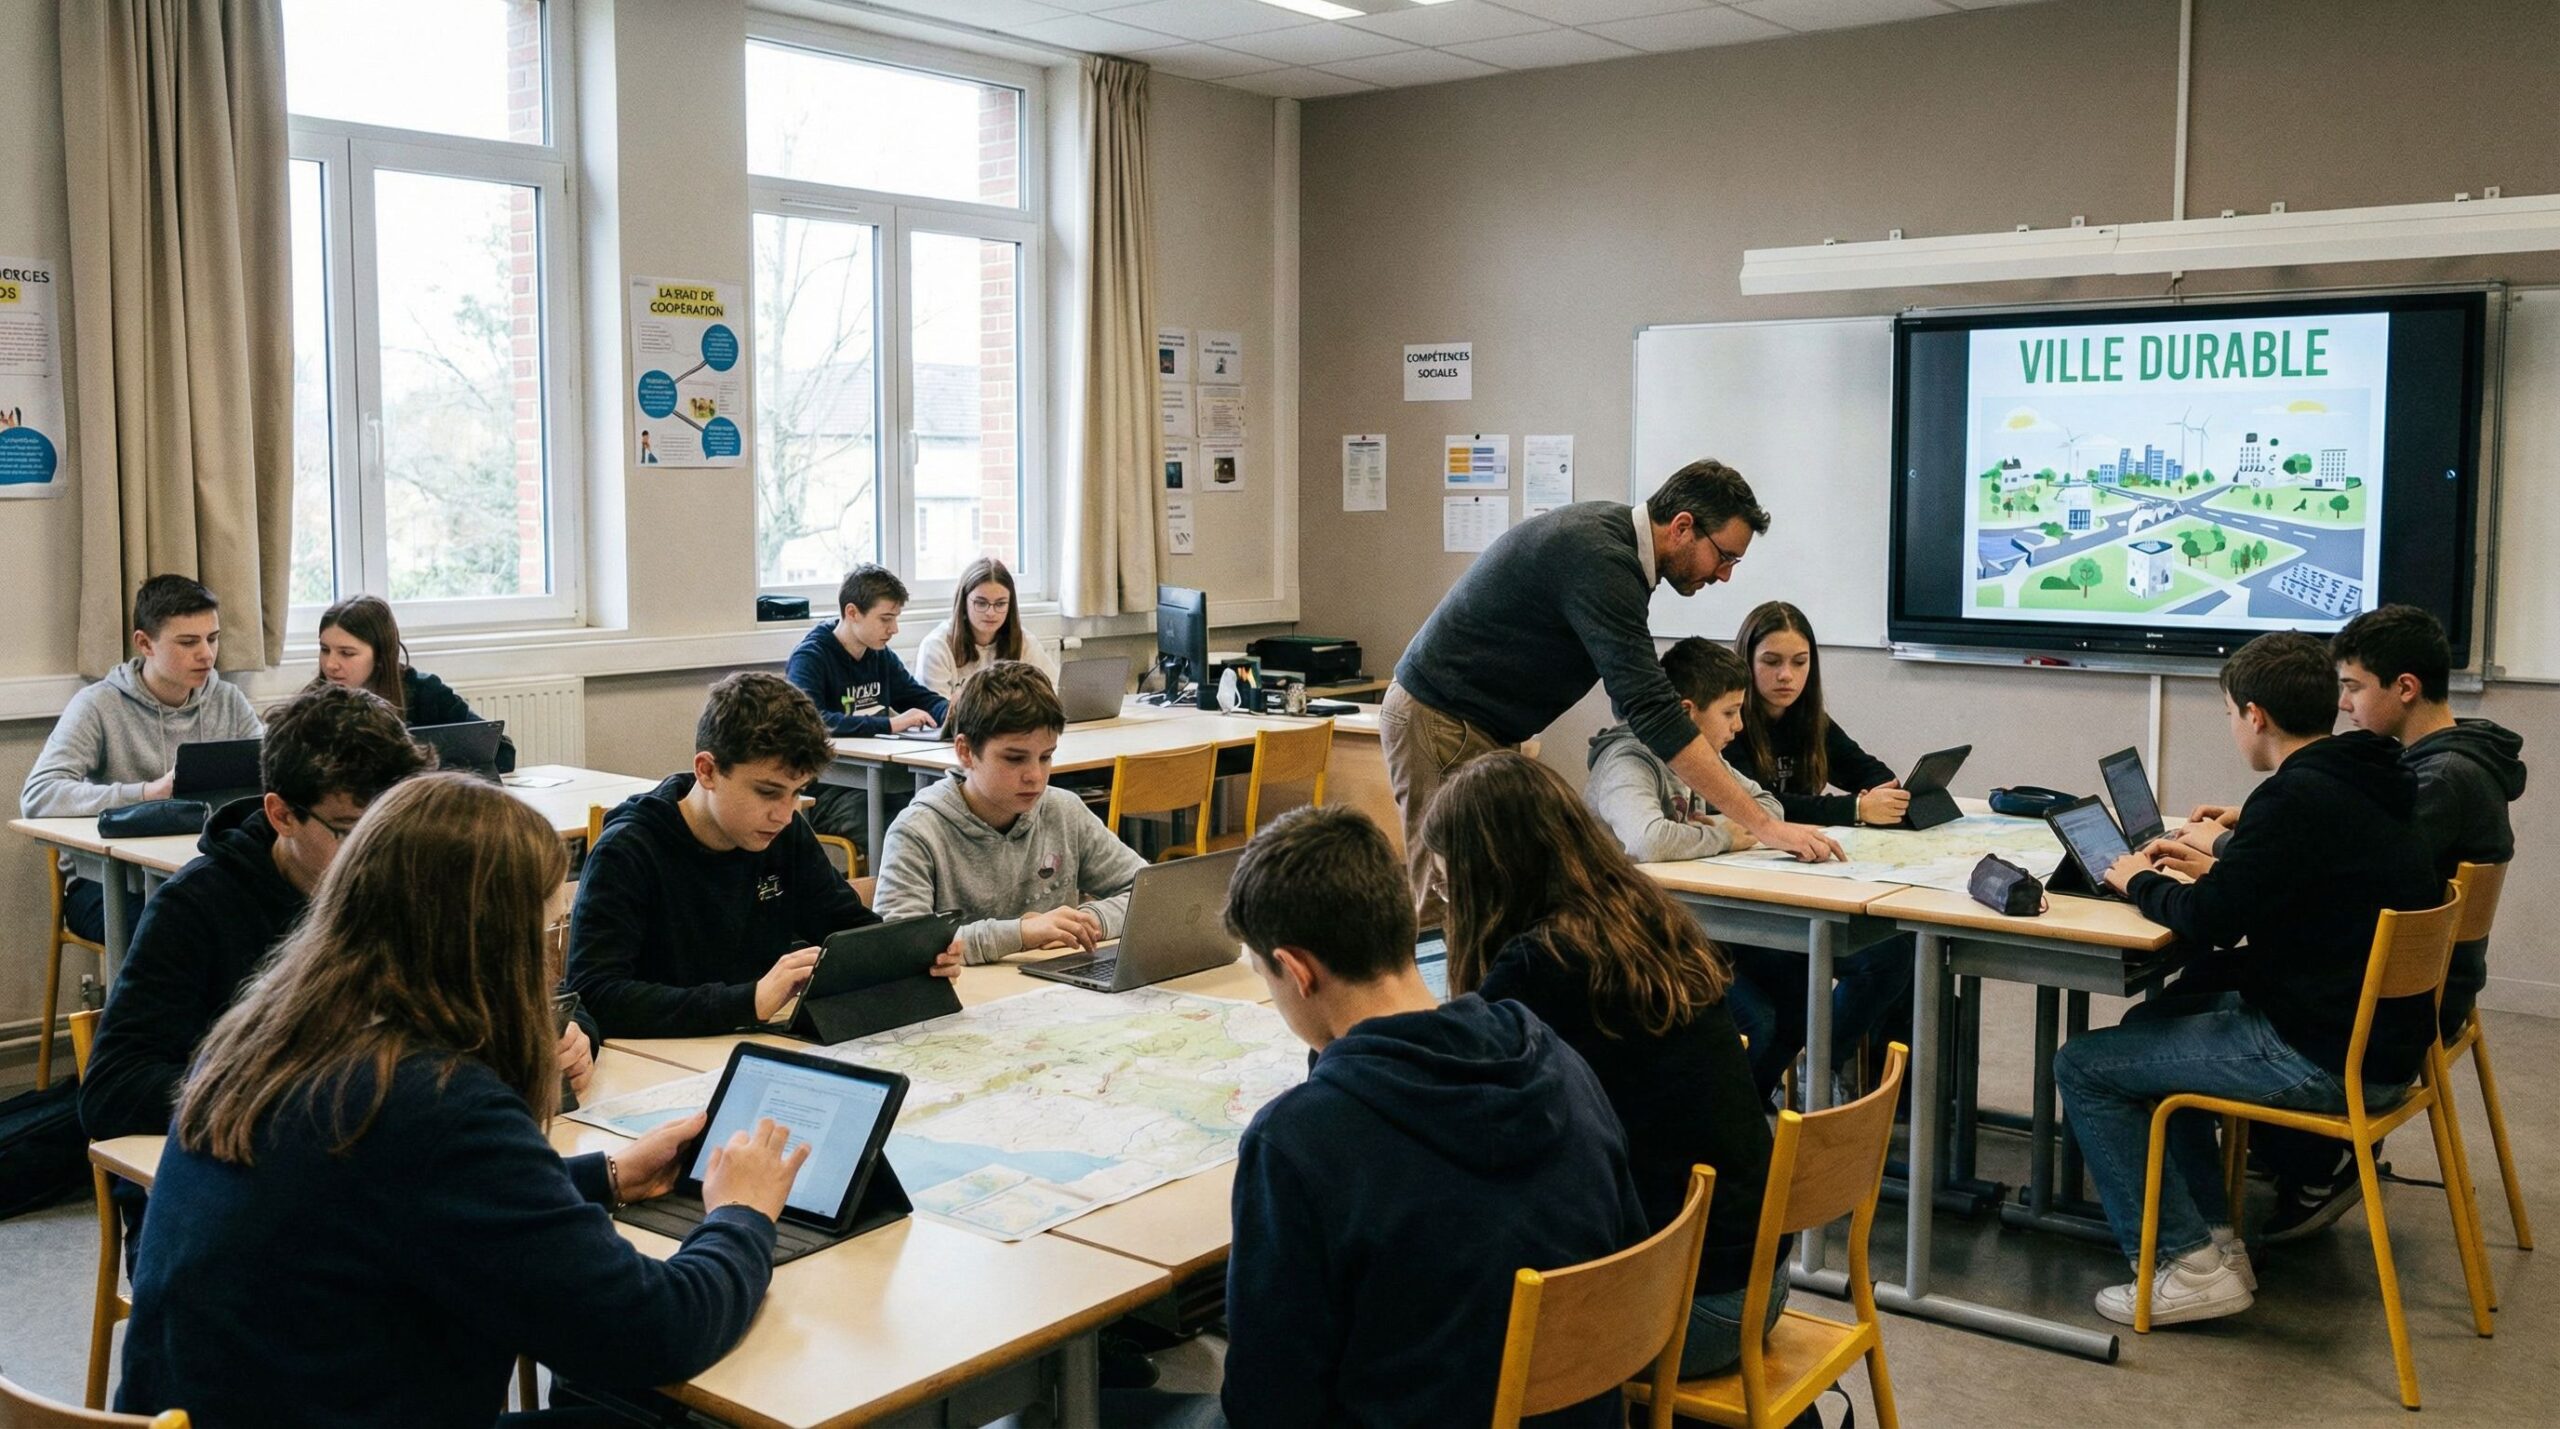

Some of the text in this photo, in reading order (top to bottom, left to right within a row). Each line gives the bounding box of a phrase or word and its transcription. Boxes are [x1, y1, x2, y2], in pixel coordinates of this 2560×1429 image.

[659, 288, 672, 299] LA
[701, 291, 715, 302] DE
[1407, 349, 1470, 363] COMPÉTENCES
[2020, 328, 2329, 384] VILLE DURABLE
[1418, 368, 1458, 378] SOCIALES
